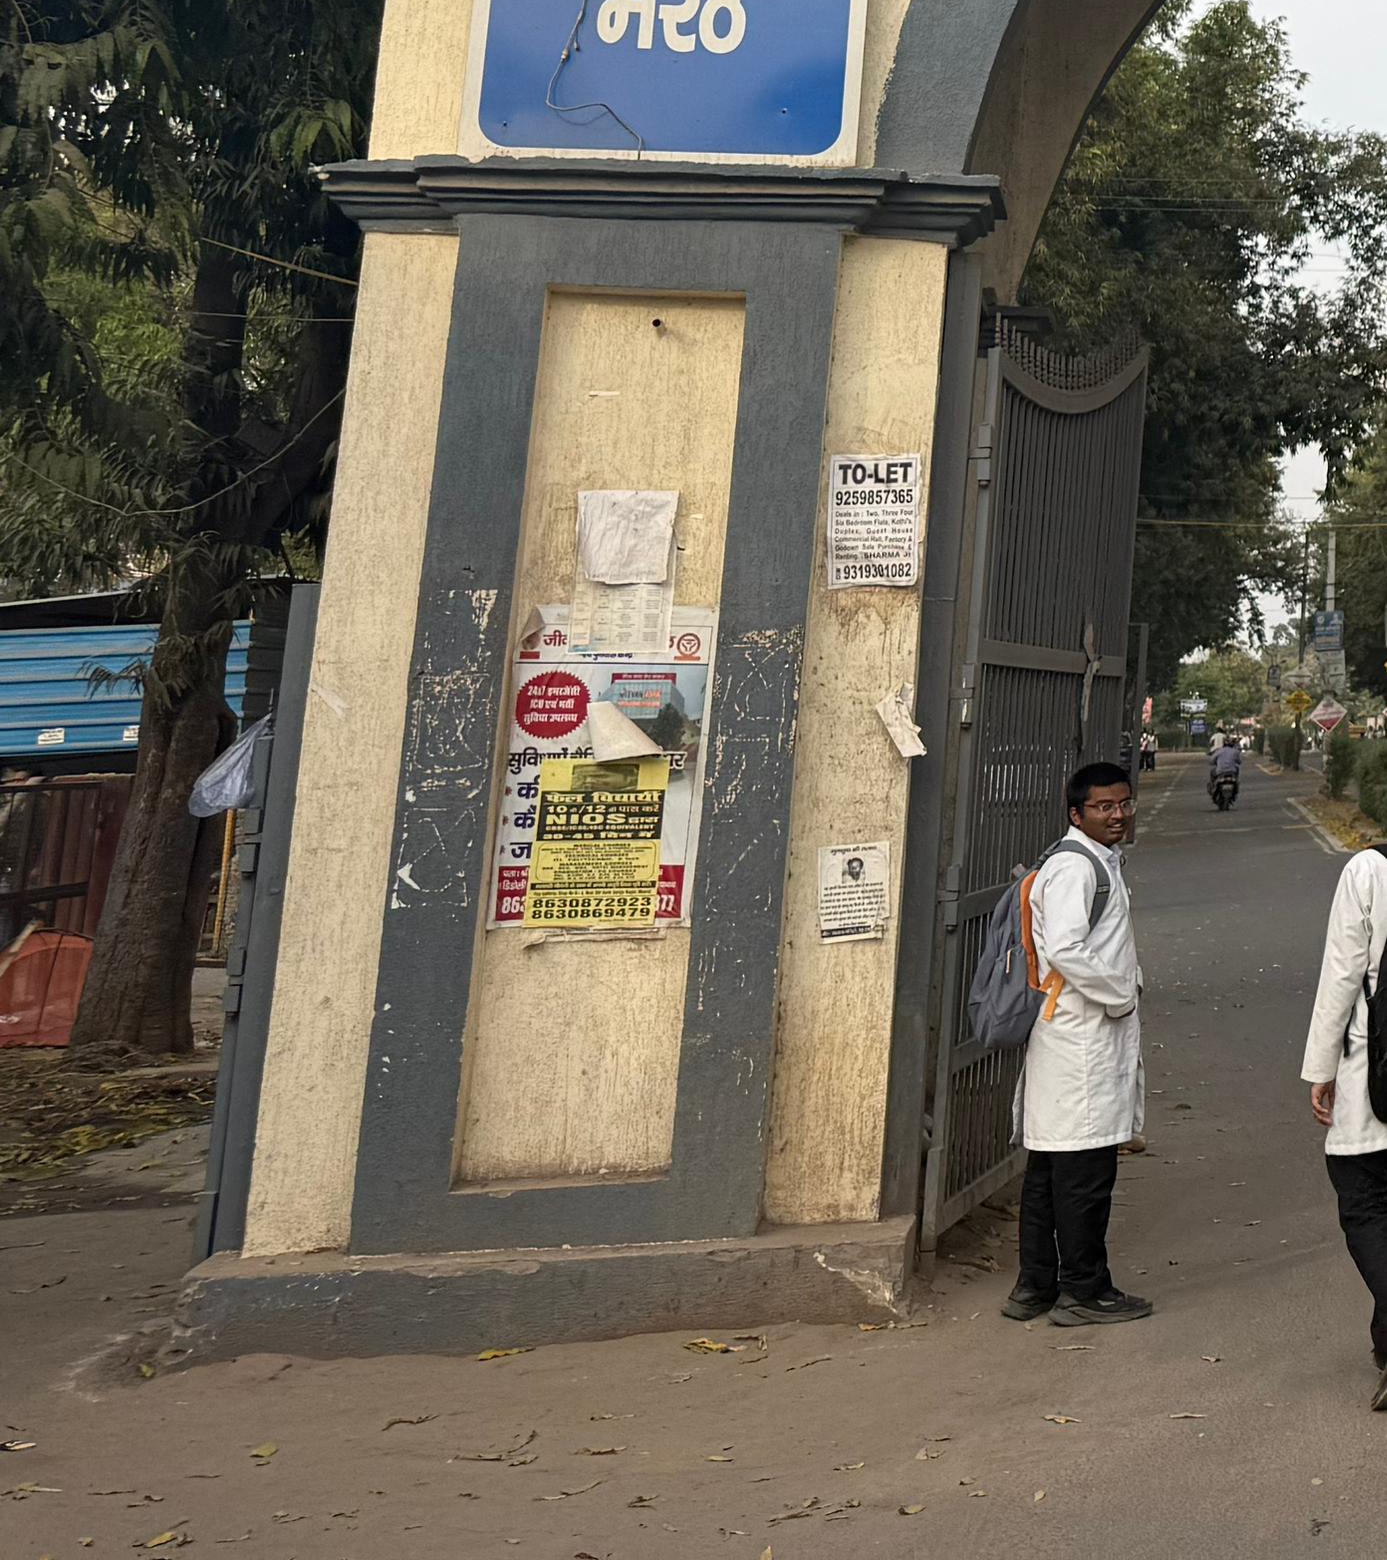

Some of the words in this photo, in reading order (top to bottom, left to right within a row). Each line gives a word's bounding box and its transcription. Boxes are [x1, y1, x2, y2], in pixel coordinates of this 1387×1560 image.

[838, 462, 912, 485] TO-LET
[836, 489, 913, 506] 9259857365
[844, 562, 912, 579] 9319301082
[545, 813, 626, 825] NIOS
[532, 897, 651, 909] 8630872923
[532, 907, 651, 919] 8630869479
